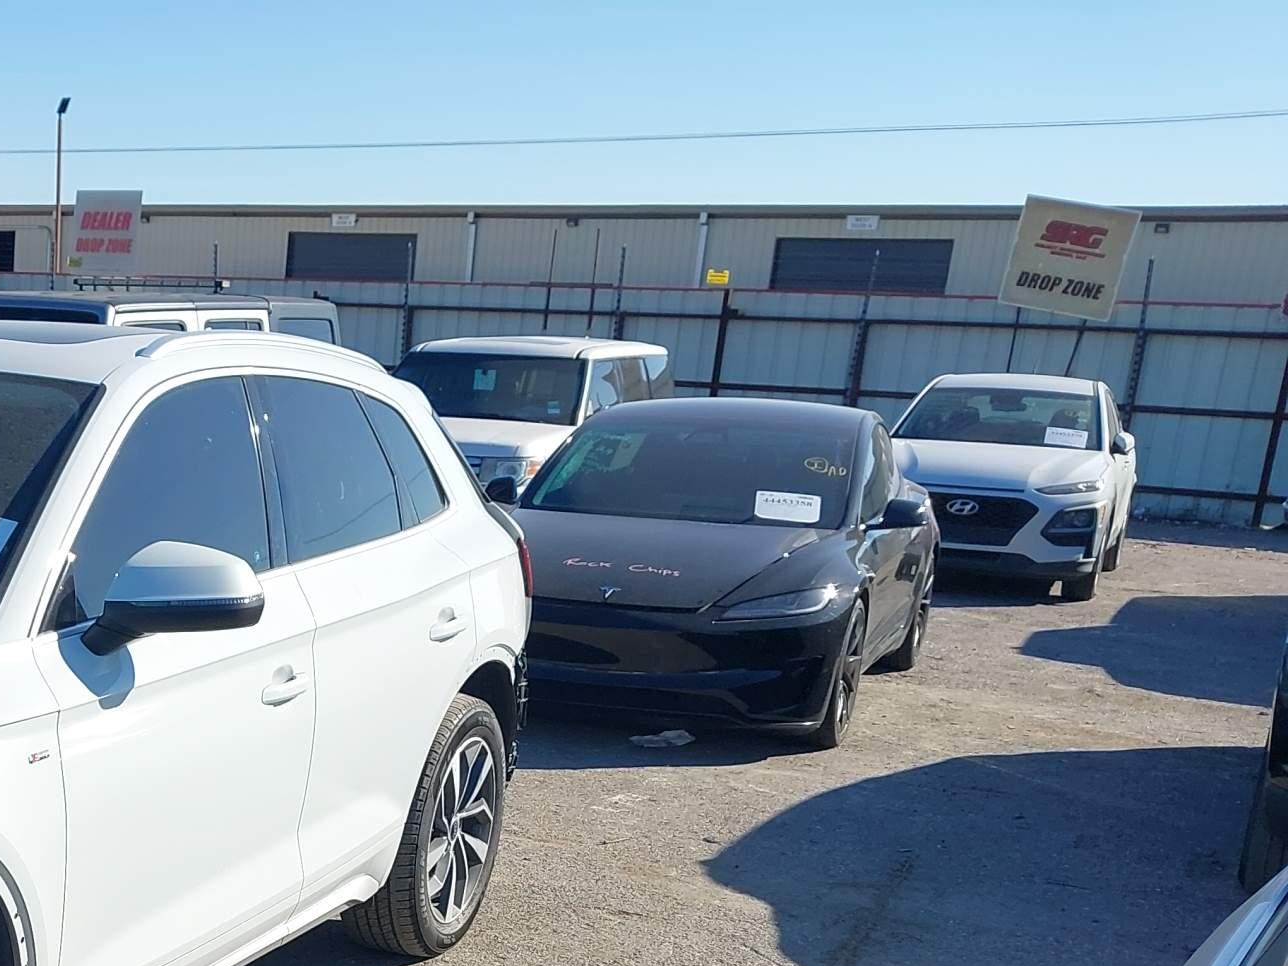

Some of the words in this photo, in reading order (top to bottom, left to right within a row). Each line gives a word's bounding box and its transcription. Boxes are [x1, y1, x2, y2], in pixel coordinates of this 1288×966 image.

[80, 211, 132, 230] DEALER
[1016, 271, 1062, 292] DROP
[1062, 278, 1105, 300] ZONE
